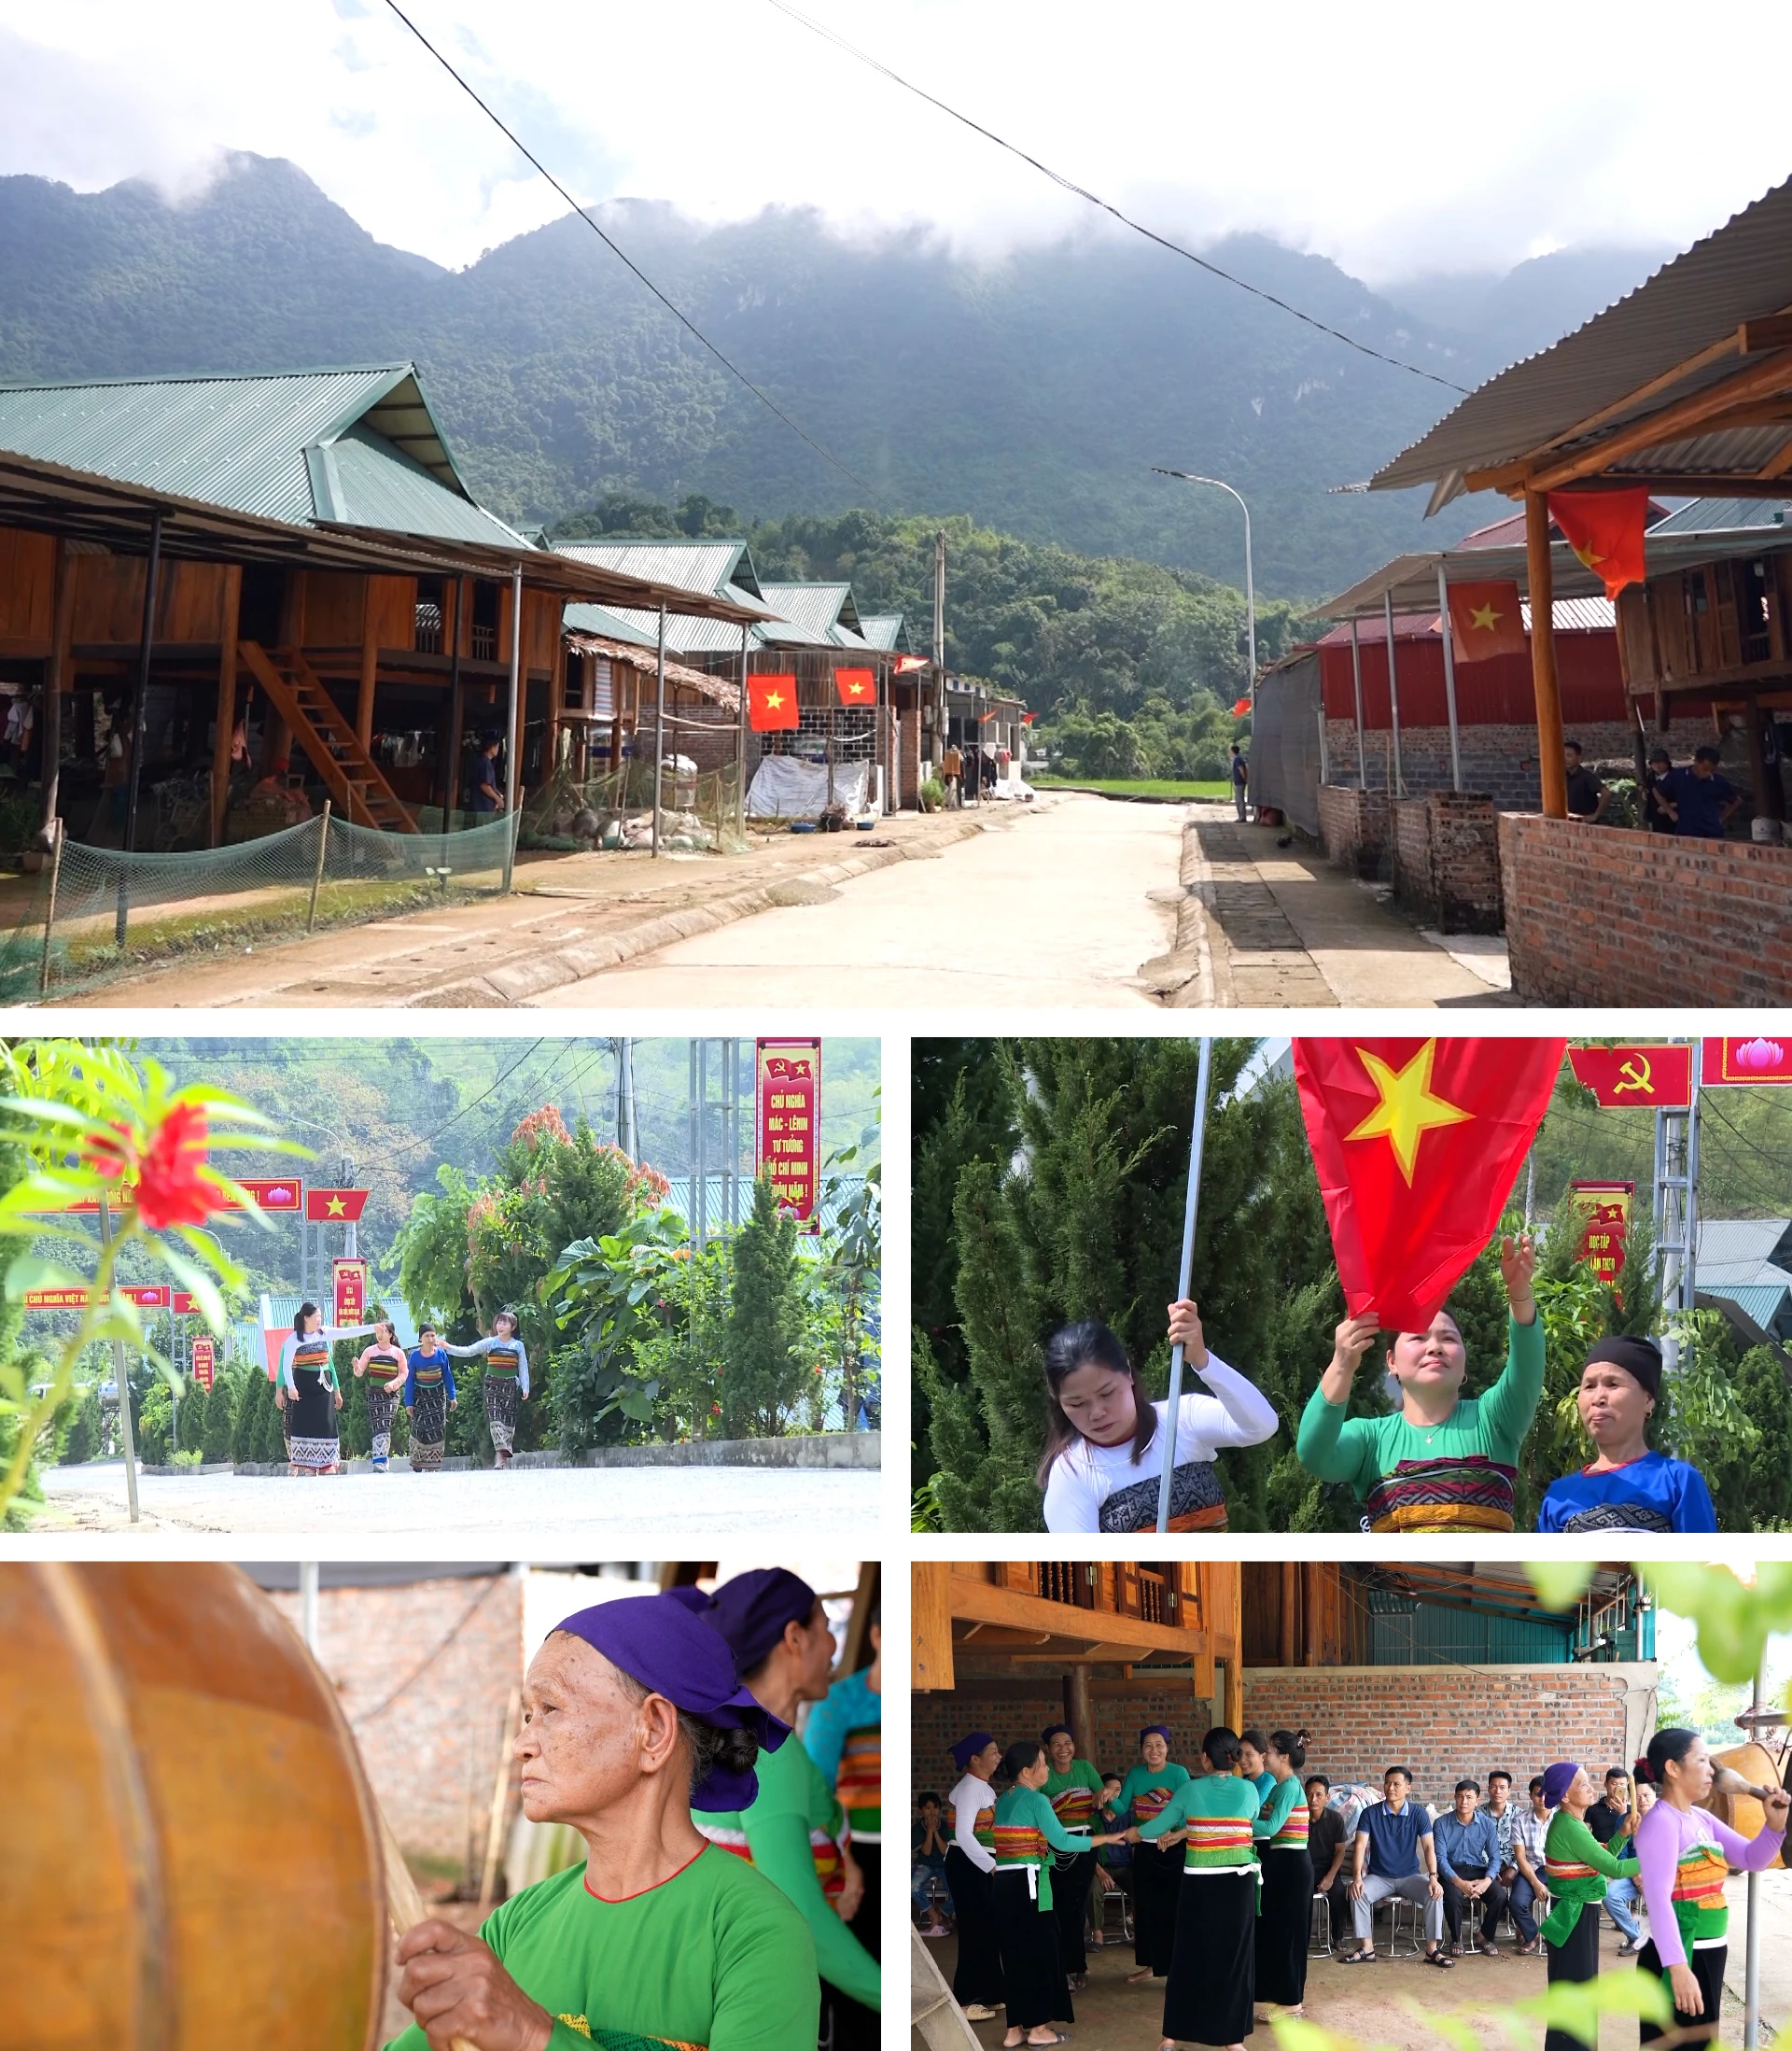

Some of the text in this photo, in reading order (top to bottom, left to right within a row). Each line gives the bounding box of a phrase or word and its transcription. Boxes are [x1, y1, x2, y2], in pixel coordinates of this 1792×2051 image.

[771, 1089, 805, 1108] CHỦ NGHĨA
[769, 1115, 783, 1131] MÁC
[789, 1115, 807, 1131] LÊNIN
[773, 1134, 804, 1153] TƯ TƯỞNG
[778, 1159, 790, 1175] CHÍ
[791, 1161, 807, 1175] MINH
[29, 1290, 42, 1304] CHỦ
[44, 1292, 64, 1304] NGHĨA
[64, 1292, 78, 1305] VIỆT
